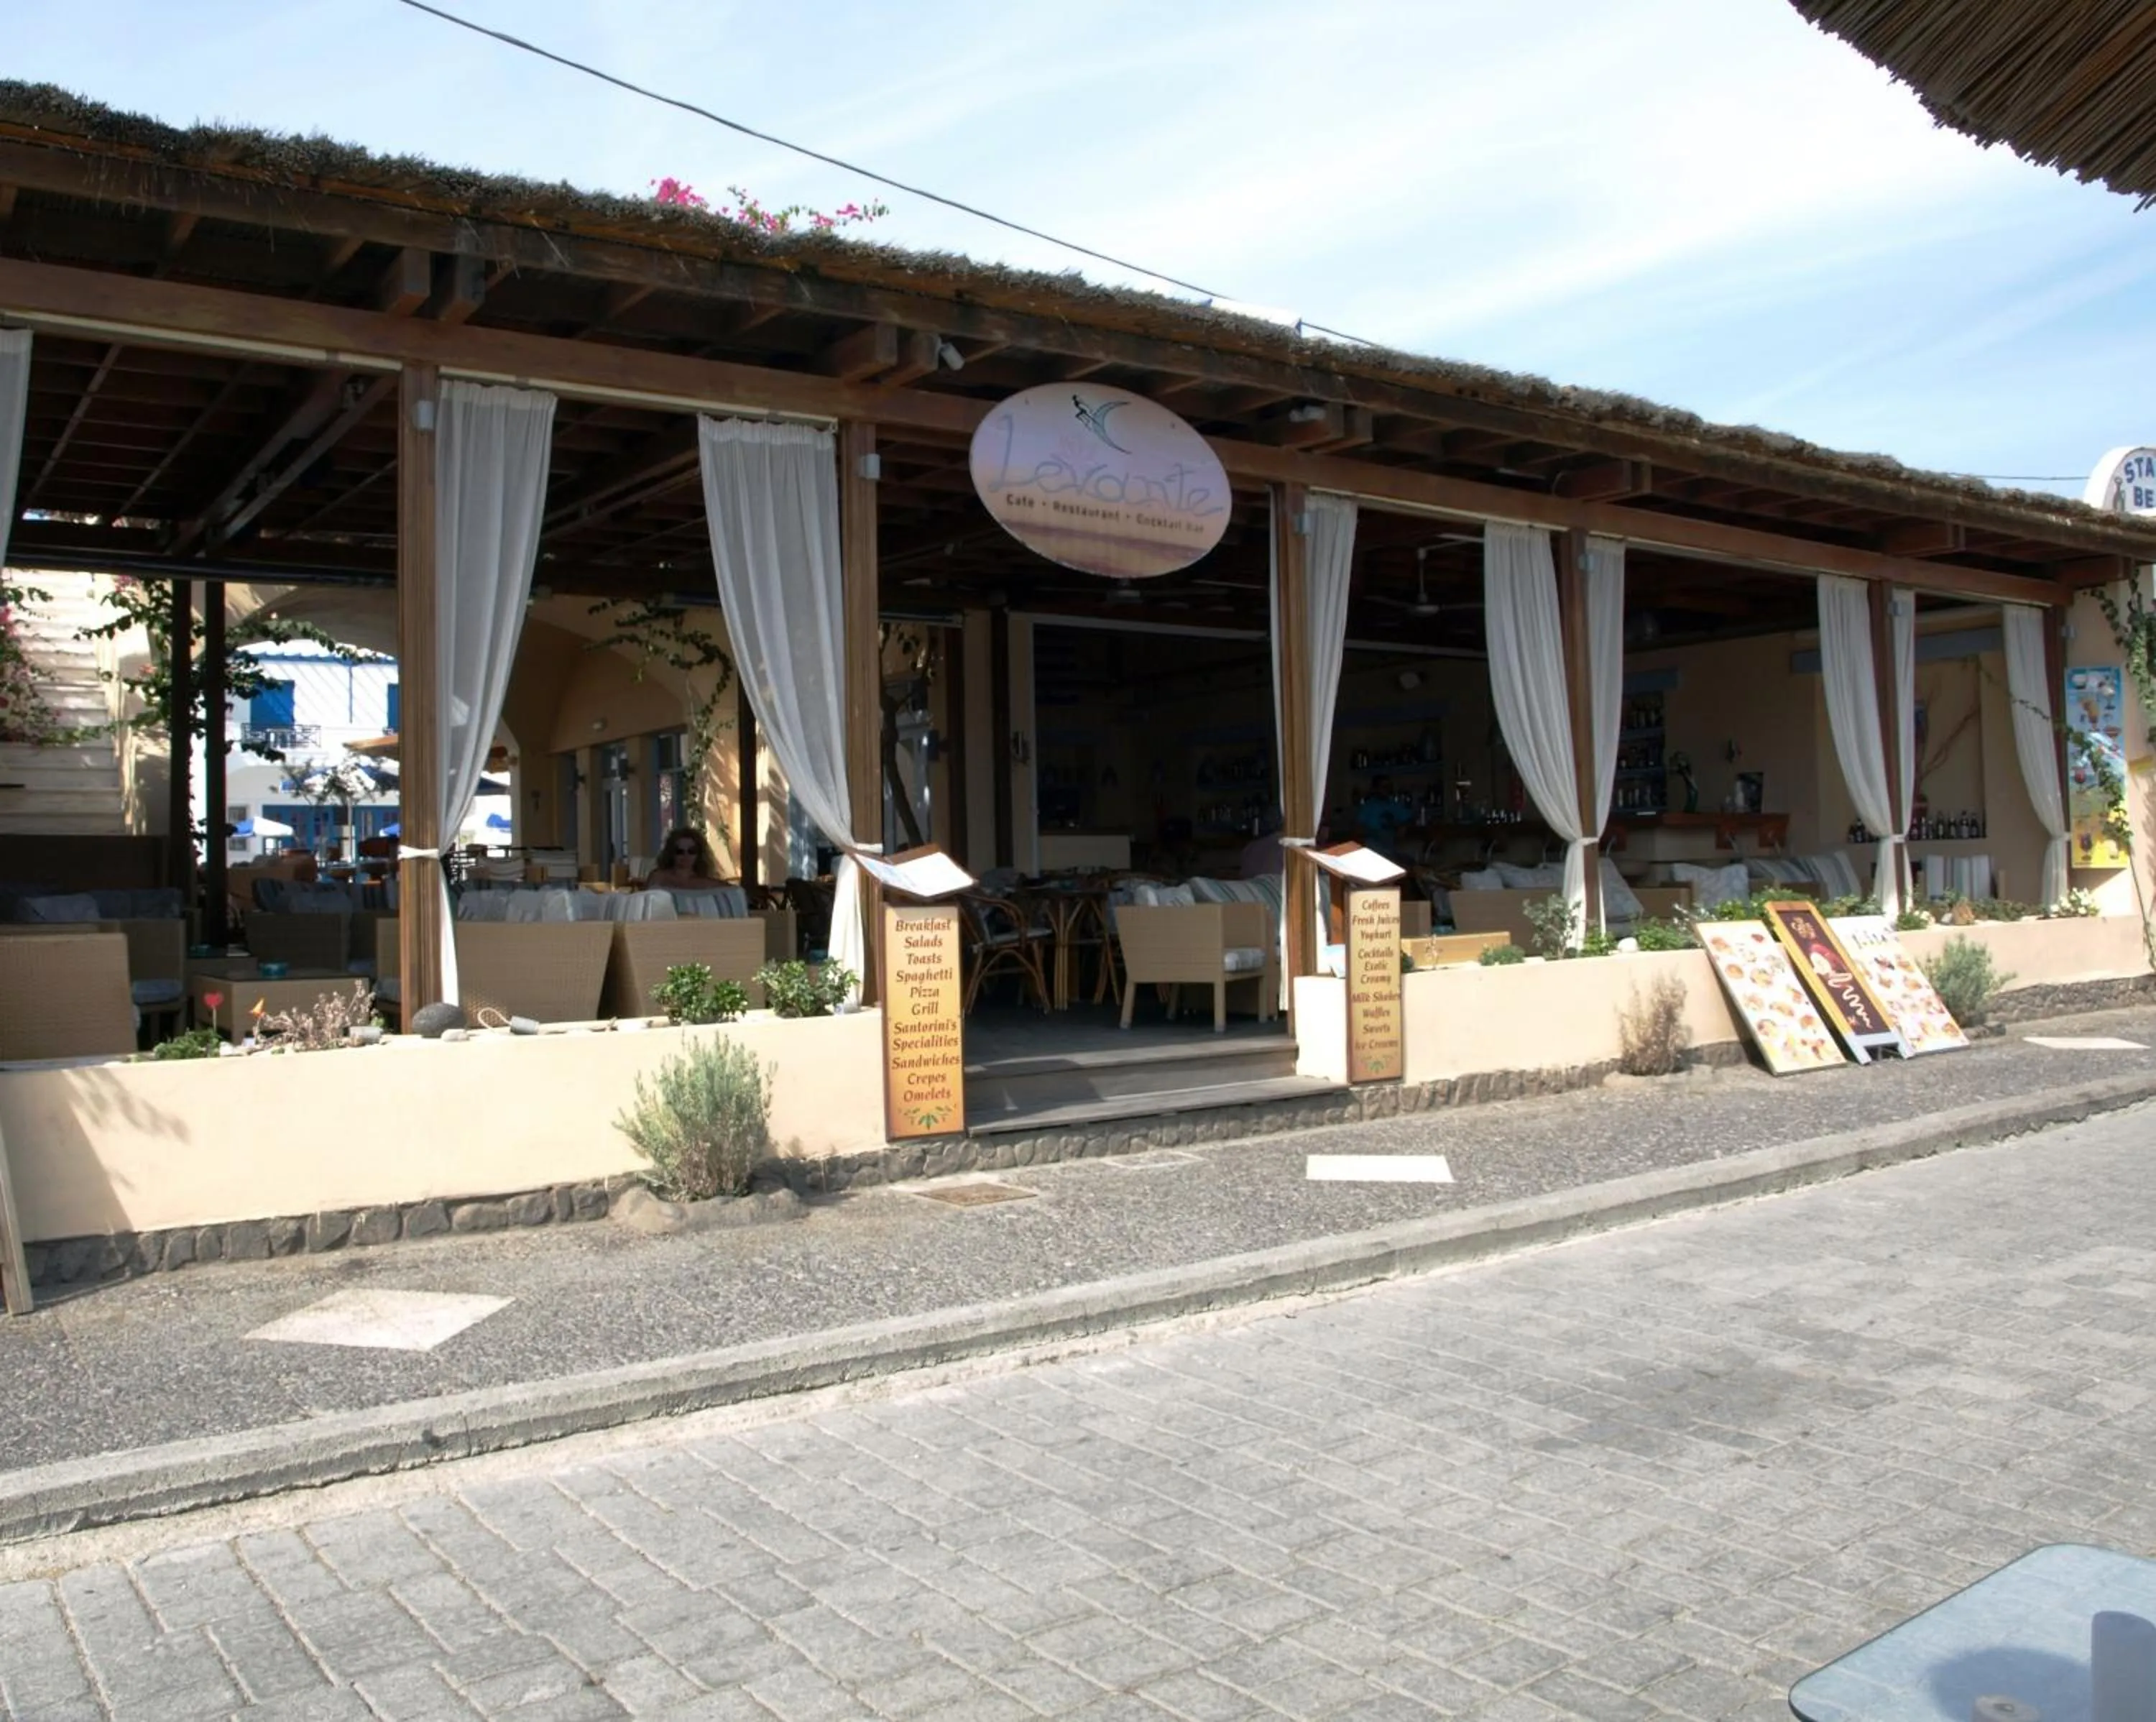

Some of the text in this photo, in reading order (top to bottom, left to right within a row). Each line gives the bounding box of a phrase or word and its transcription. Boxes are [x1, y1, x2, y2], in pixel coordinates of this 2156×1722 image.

[988, 414, 1223, 516] Levante
[1053, 500, 1120, 522] Restaurant
[1136, 513, 1181, 531] Cocktail
[895, 917, 952, 933] Breakfast
[1352, 915, 1374, 926] Fresh
[903, 936, 943, 949] Salads
[1360, 929, 1392, 941] Yoghurt
[906, 952, 942, 965] Toasts
[1358, 947, 1394, 959] Cocktails
[895, 967, 953, 985] Spaghetti
[910, 986, 939, 998] Pizza
[911, 1001, 939, 1016] Grill
[893, 1020, 957, 1035] Santorini's
[892, 1035, 959, 1051] Specialities
[891, 1053, 961, 1070] Sandwiches
[907, 1071, 946, 1087] Crepes
[903, 1087, 952, 1102] Omelets
